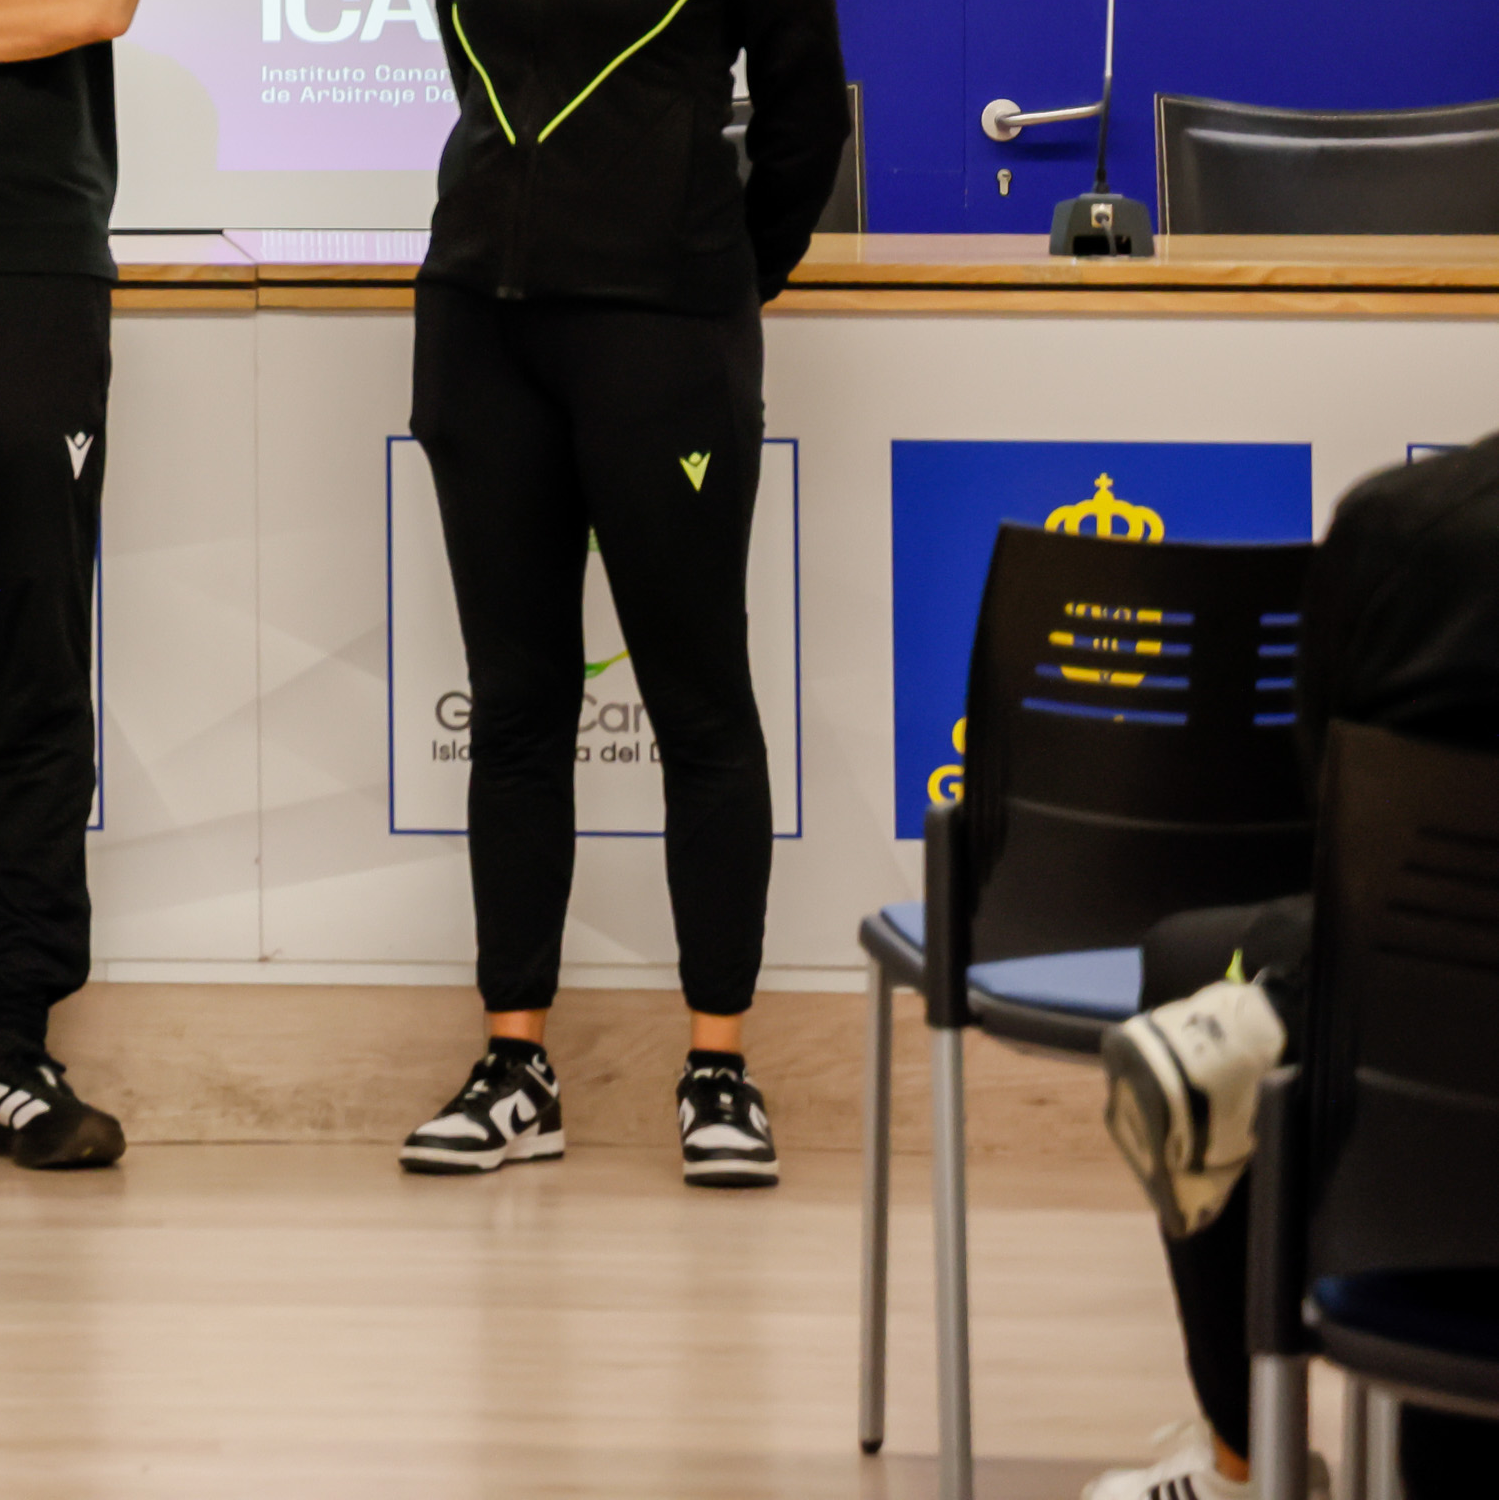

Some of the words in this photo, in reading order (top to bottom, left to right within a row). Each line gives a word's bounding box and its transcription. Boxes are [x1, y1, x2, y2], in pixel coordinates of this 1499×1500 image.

[261, 65, 366, 82] Instituto
[261, 86, 291, 103] de
[300, 86, 415, 107] Arbitraje
[601, 740, 640, 762] del
